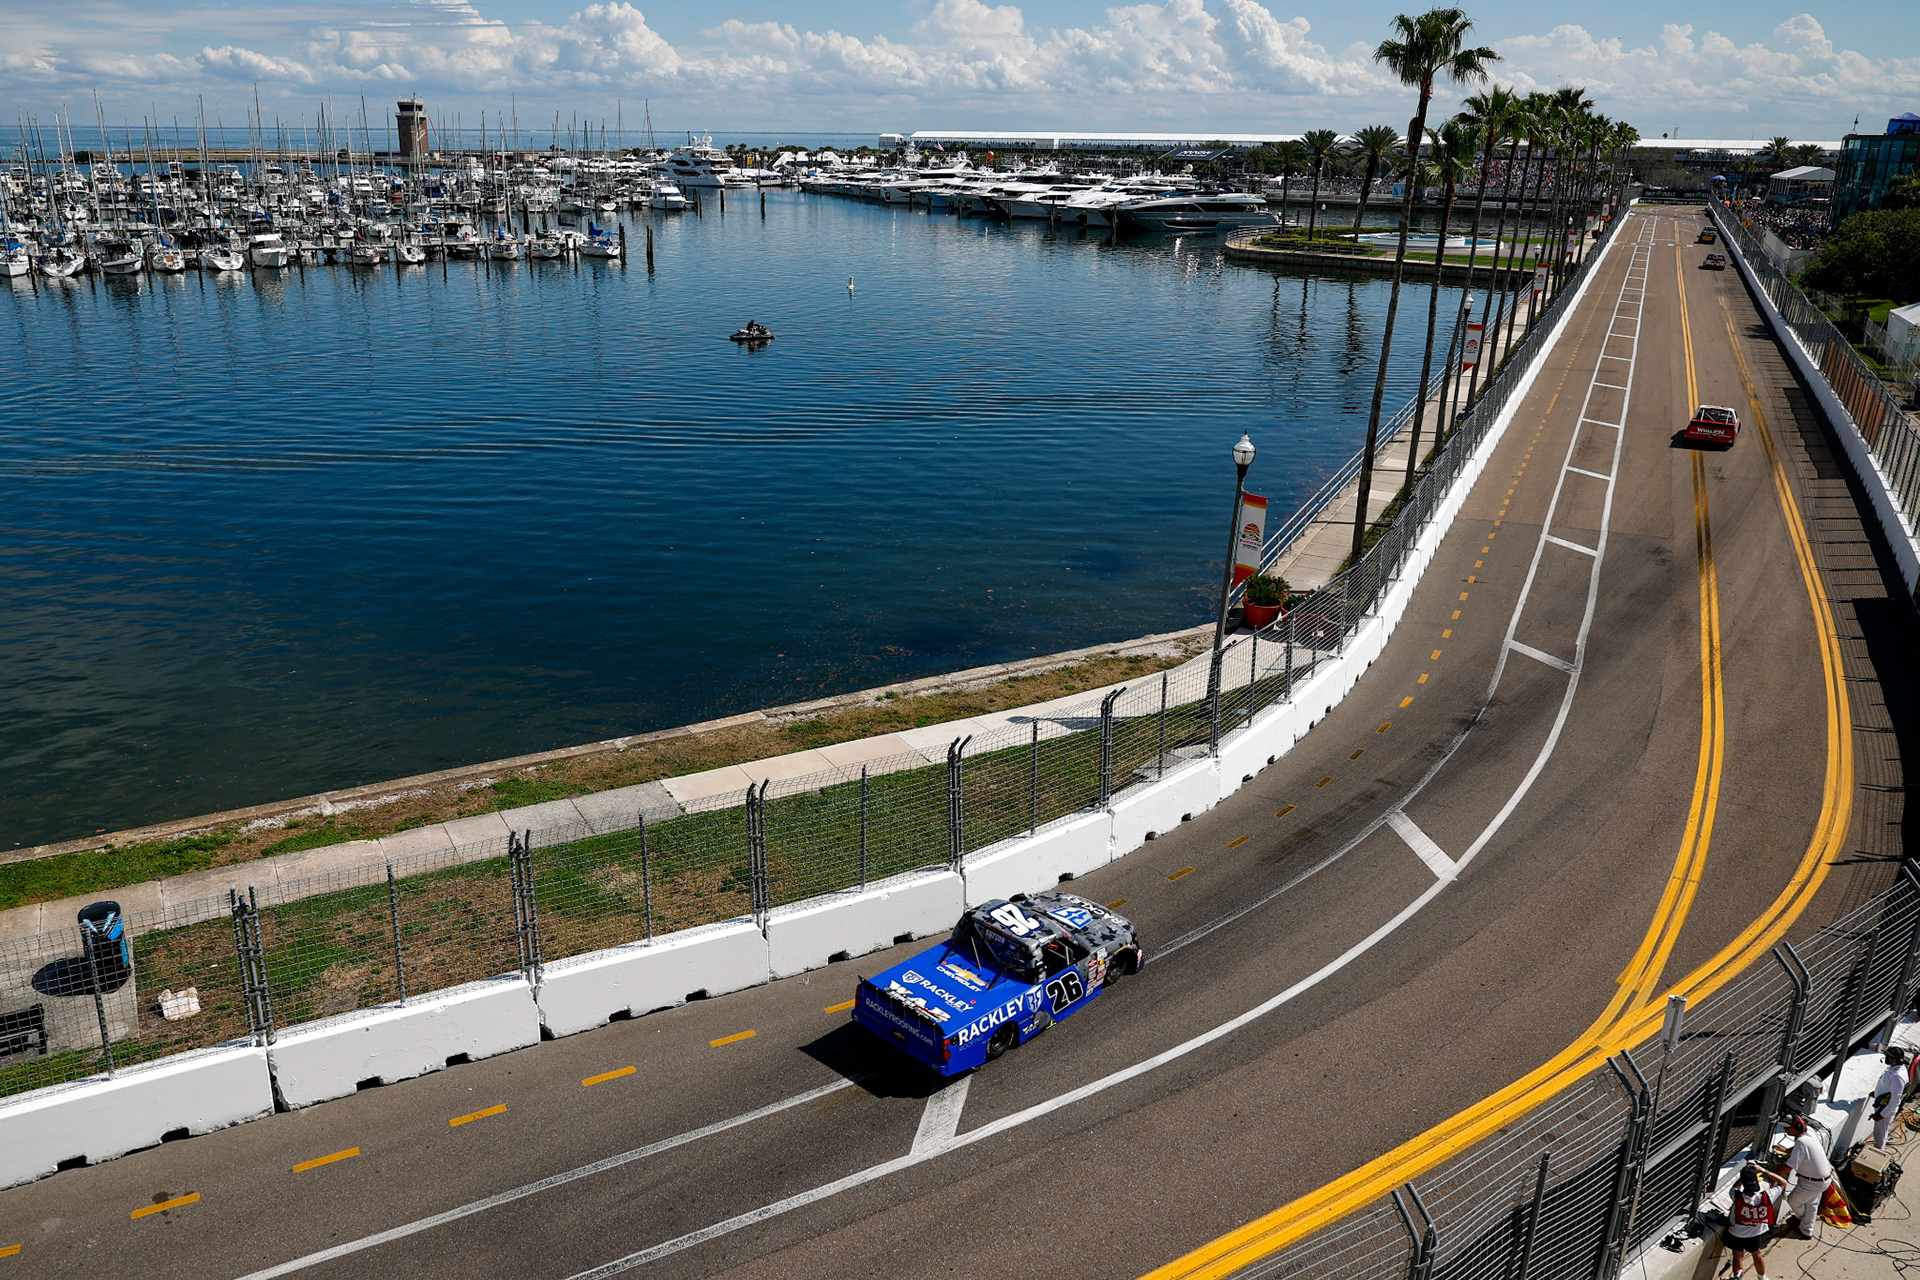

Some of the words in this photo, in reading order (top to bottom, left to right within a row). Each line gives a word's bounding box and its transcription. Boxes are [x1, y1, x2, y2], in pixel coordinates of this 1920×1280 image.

[1696, 427, 1725, 435] WHELEN
[919, 979, 974, 1012] RACKLEY
[936, 965, 983, 993] CHEVROLET
[1045, 970, 1085, 1015] 26
[865, 997, 934, 1047] RACKLEYROOFING.com
[957, 993, 1025, 1047] RACKLEY
[1740, 1206, 1768, 1219] 413
